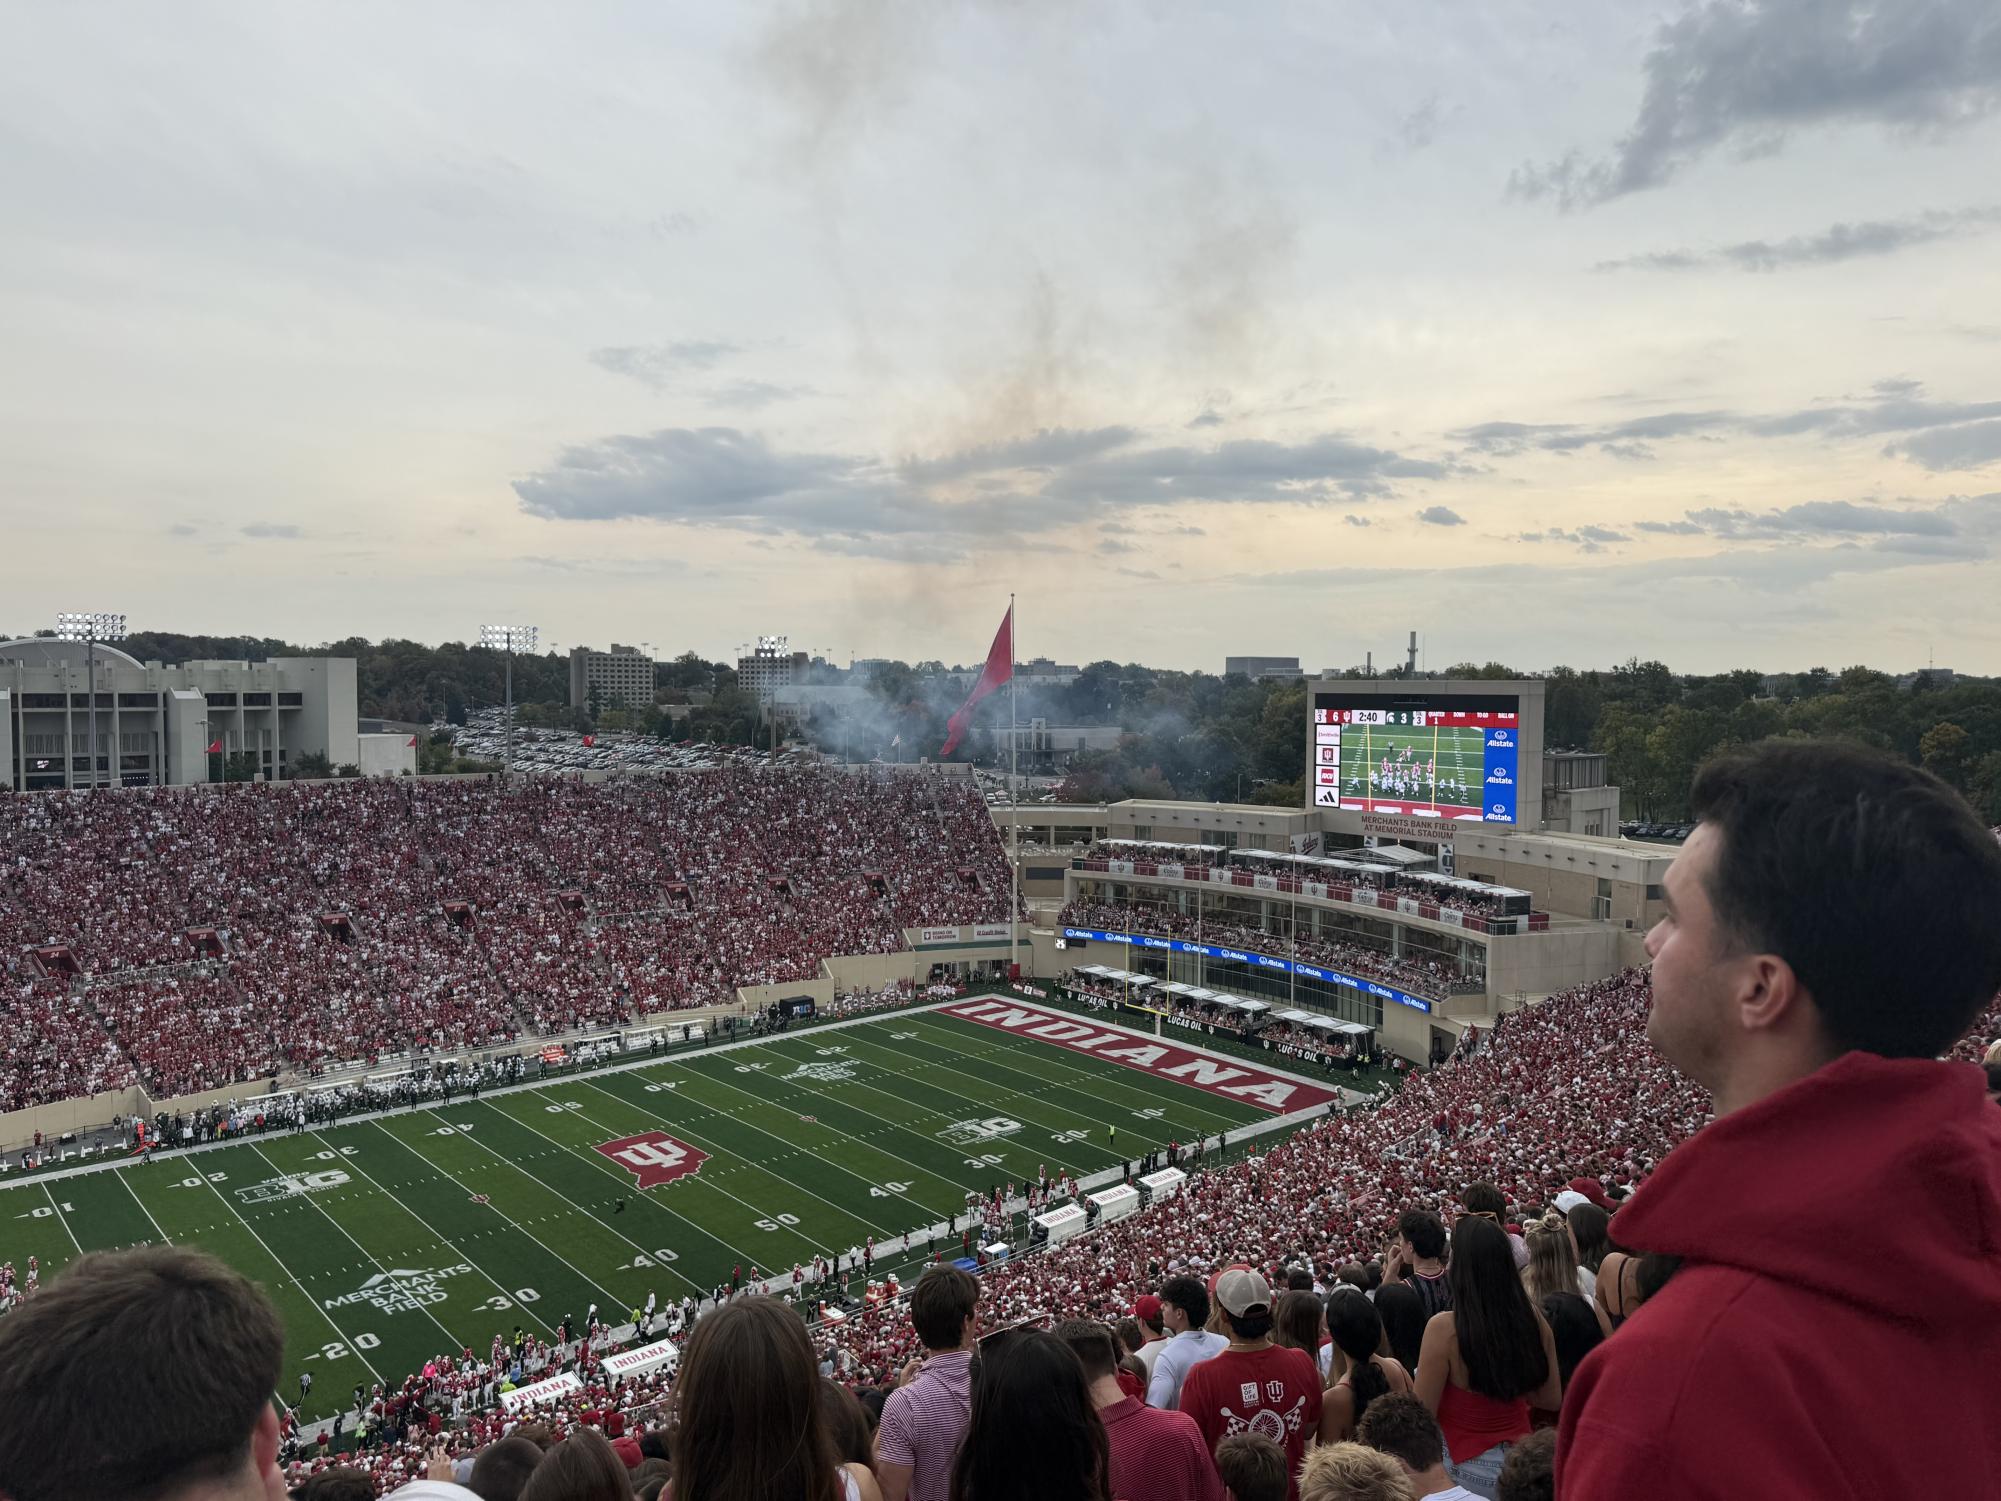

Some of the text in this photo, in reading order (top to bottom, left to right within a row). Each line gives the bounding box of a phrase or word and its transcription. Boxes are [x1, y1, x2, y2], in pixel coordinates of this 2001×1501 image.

[1332, 712, 1339, 720] 6
[1360, 712, 1377, 722] 2:40
[1401, 713, 1407, 724] 3
[1362, 816, 1457, 831] MERCHANTS BANK FIELD
[1485, 814, 1512, 822] Allstate
[1375, 825, 1416, 836] MEMORIAL
[1418, 830, 1454, 840] STADIUM
[1075, 930, 1093, 938] Allstate
[1230, 951, 1247, 960] Allstate
[1267, 959, 1285, 968] Allstate
[1304, 968, 1322, 977] Allstate
[1341, 976, 1357, 987] Allstate
[1376, 987, 1392, 998] Allstate
[1410, 999, 1426, 1010] Allstate
[1168, 1015, 1202, 1031] LUCAS OIL
[951, 1001, 1302, 1108] INDIANA
[1304, 1051, 1318, 1062] OIL
[644, 1081, 676, 1093] 40
[545, 1101, 584, 1113] 50
[1131, 1109, 1158, 1120] 10
[436, 1122, 474, 1136] 40
[1052, 1130, 1084, 1143] 20
[315, 1146, 360, 1160] 30
[613, 1139, 688, 1168] IU
[964, 1154, 998, 1169] 30
[182, 1171, 228, 1187] 20
[1150, 1170, 1179, 1184] INDIANA
[869, 1181, 906, 1198] 40
[1096, 1188, 1132, 1202] INDIANA
[32, 1202, 76, 1218] 10
[1043, 1208, 1079, 1223] INDIANA
[753, 1213, 800, 1232] 50
[633, 1249, 680, 1268] 40
[325, 1264, 473, 1310] MERCHANTS
[370, 1282, 444, 1308] BANK
[486, 1288, 541, 1310] 30
[384, 1292, 448, 1315] FIELD
[321, 1333, 381, 1360] 20
[613, 1346, 668, 1368] INDIANA
[511, 1379, 572, 1403] INDIANA
[1266, 1380, 1283, 1403] IU
